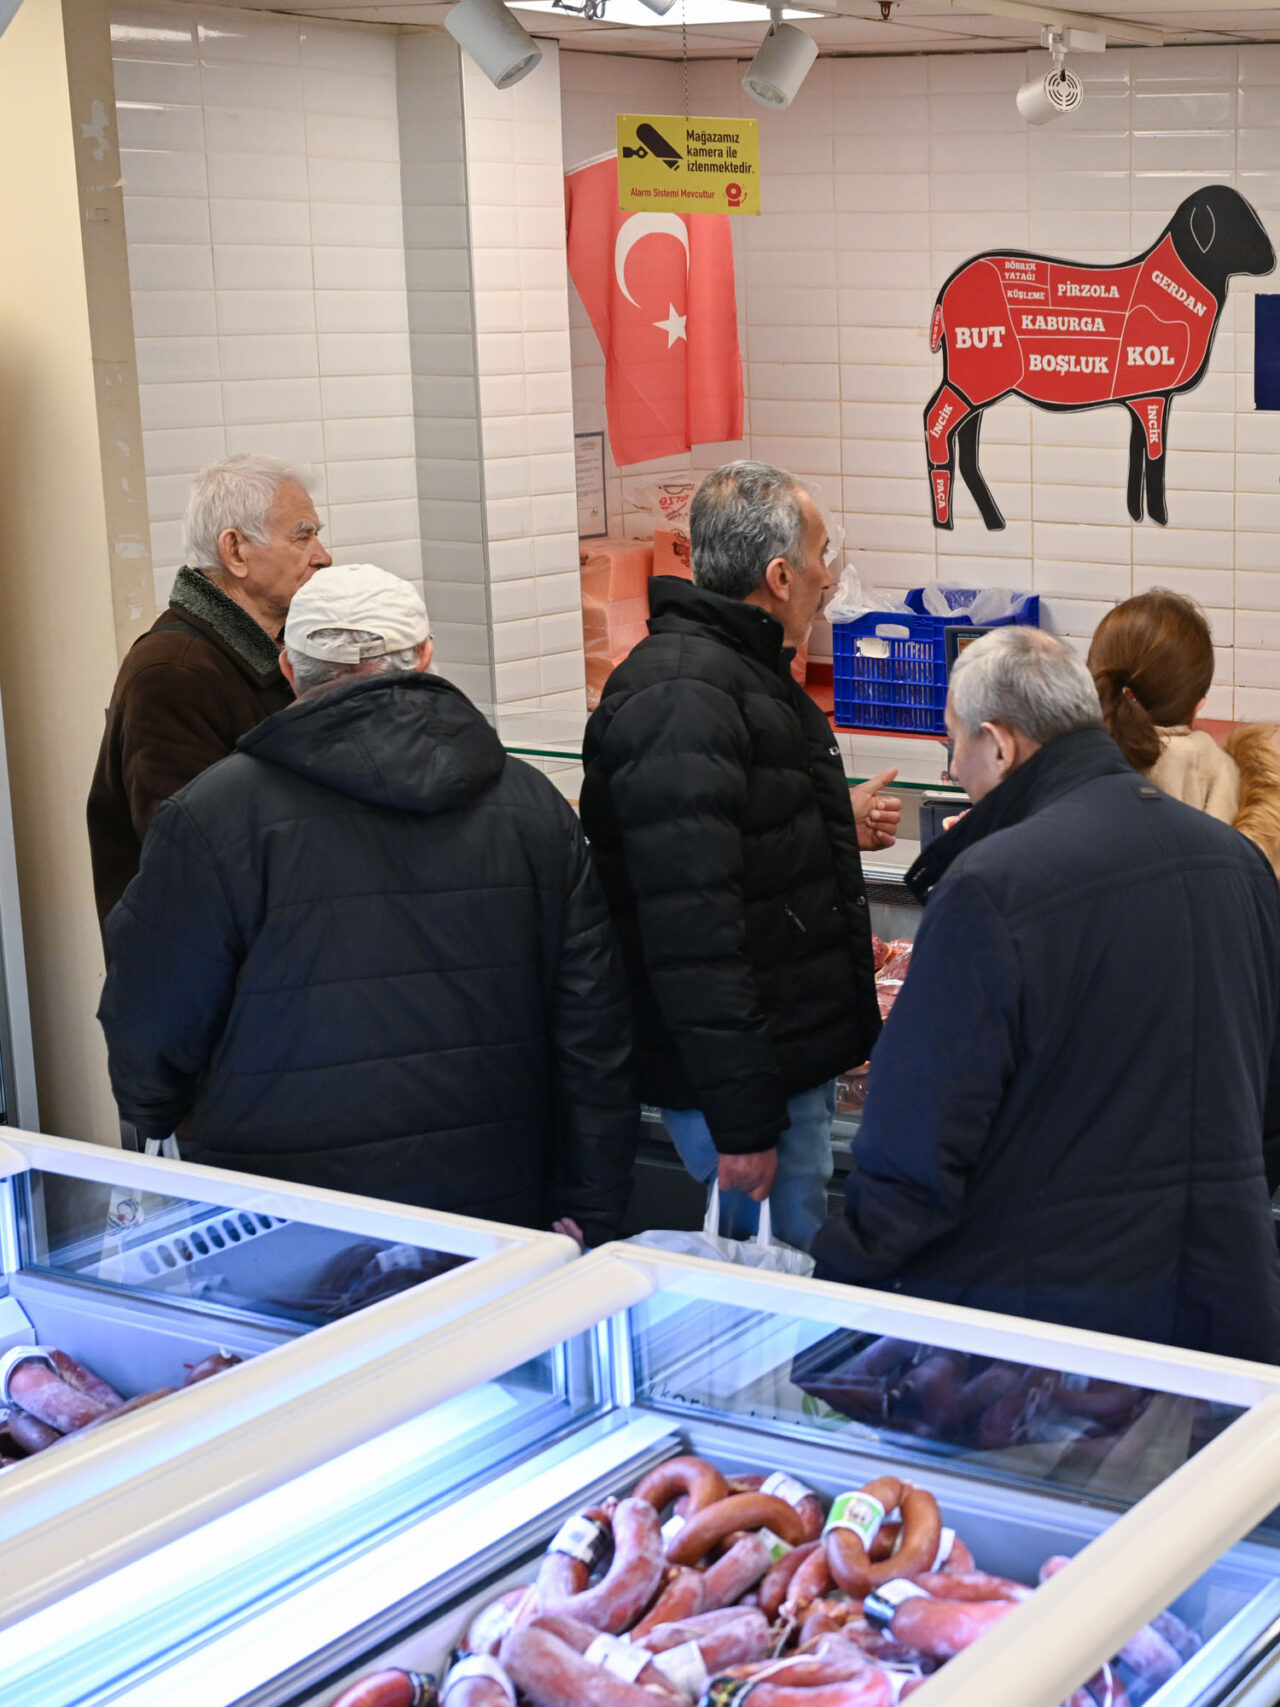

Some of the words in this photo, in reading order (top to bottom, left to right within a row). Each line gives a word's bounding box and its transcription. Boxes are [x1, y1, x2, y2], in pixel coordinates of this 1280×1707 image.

[686, 129, 740, 145] Mağazamız
[686, 144, 724, 158] kamera
[726, 145, 738, 158] ile
[687, 160, 755, 174] izlenmektedir.
[630, 187, 652, 198] Alarm
[653, 188, 679, 198] Sistemi
[1004, 260, 1037, 272] BÖBREK
[1004, 270, 1036, 282] YATAĞI
[1006, 289, 1045, 300] KÜŞLEME
[1057, 280, 1120, 298] PİRZOLA
[1151, 270, 1207, 317] GERDAN
[1021, 315, 1106, 332] KABURGA
[955, 326, 1006, 349] BUT
[1126, 345, 1175, 366] KOL
[1028, 354, 1109, 376] BOŞLUK
[930, 402, 955, 439] İNCİK
[1147, 404, 1159, 443] İNCİK
[936, 478, 946, 509] PAÇA
